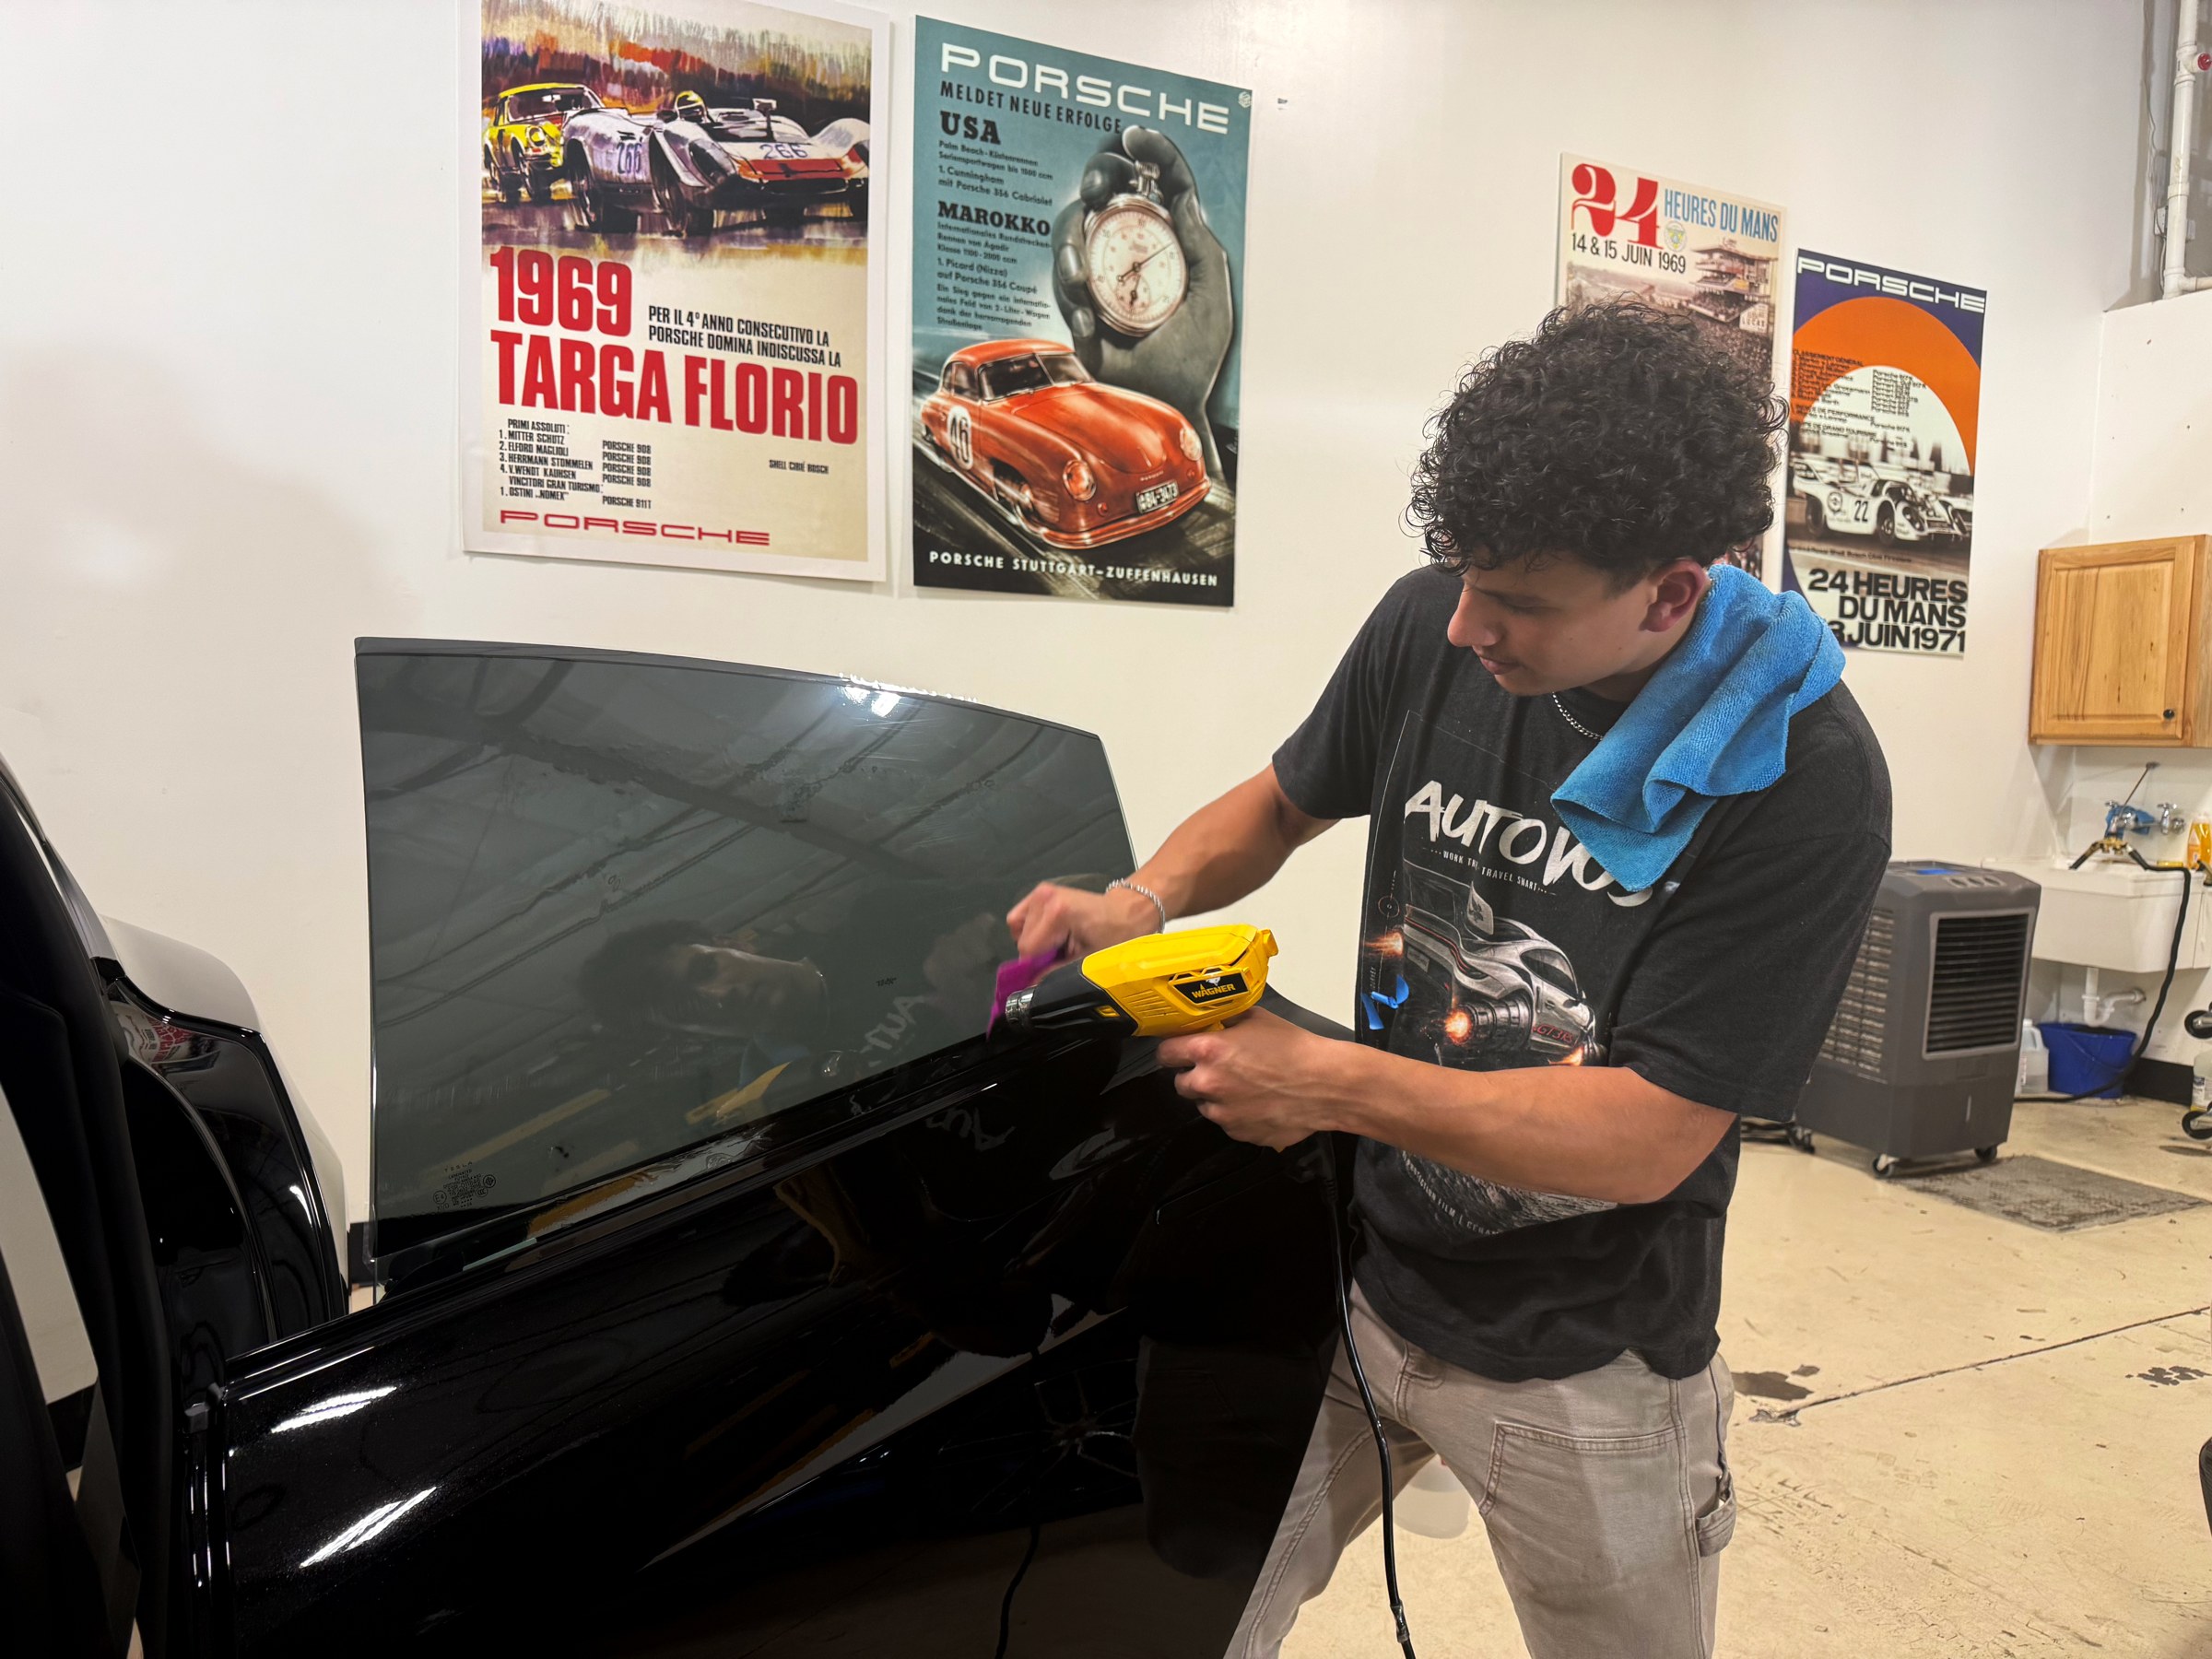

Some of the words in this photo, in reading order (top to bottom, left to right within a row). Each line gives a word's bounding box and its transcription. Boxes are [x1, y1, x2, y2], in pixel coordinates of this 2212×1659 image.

[941, 42, 1229, 135] PORSCHE
[940, 80, 1004, 109] MELDET
[1010, 96, 1051, 120] NEUE
[1056, 106, 1122, 135] ERFOLGE
[940, 111, 1001, 145] USA
[956, 180, 991, 194] Porsche
[937, 200, 1051, 236] MAROKKO
[1571, 162, 1664, 250] 24
[1665, 188, 1716, 229] HEURES
[1720, 202, 1738, 233] DU
[1741, 207, 1779, 243] MANS
[1571, 231, 1586, 253] 14
[1590, 236, 1601, 256] &
[1604, 241, 1618, 259] 15
[1621, 244, 1653, 267] JUIN
[1658, 252, 1687, 274] 1969
[490, 245, 632, 337] 1969
[954, 272, 991, 287] Porsche
[1797, 256, 1986, 313] PORSCHE
[649, 305, 670, 324] PER
[674, 309, 684, 326] IL
[702, 313, 733, 333] ANNO
[737, 319, 813, 345] CONSECUTIVO
[817, 330, 830, 347] LA
[649, 324, 704, 348] PORSCHE
[708, 333, 753, 356] DOMINA
[757, 340, 825, 366] INDISCUSSA
[829, 351, 841, 368] LA
[490, 329, 672, 424] TARGA
[684, 354, 858, 445] FLORIO
[508, 418, 530, 430] PRIMI
[499, 429, 508, 440] 1.
[508, 429, 534, 442] MITTER
[602, 440, 634, 453] PORSCHE
[637, 443, 652, 454] 908
[499, 441, 508, 451] 2.
[508, 441, 534, 453] ELFORD
[535, 444, 569, 457] MAGLIOLI
[602, 452, 634, 464] PORSCHE
[637, 454, 652, 465] 908
[499, 453, 508, 463] 3.
[508, 453, 549, 466] HERRMANN
[551, 457, 594, 470] STOMMELEN
[602, 463, 634, 476] PORSCHE
[637, 465, 652, 477] 908
[500, 464, 508, 474] 4.
[543, 467, 577, 479] KAUHSEN
[602, 474, 634, 486] PORSCHE
[637, 477, 652, 488] 908
[500, 487, 509, 497] 1.
[509, 487, 534, 499] OSTINI
[602, 495, 634, 508] PORSCHE
[509, 476, 545, 488] VINCITORI
[547, 479, 567, 490] GRAN
[500, 510, 770, 547] PORSCHE
[1854, 500, 1869, 523] 22
[929, 550, 1005, 570] PORSCHE
[1013, 558, 1218, 587] STUTTGART-ZUFFENHAUSEN
[1808, 568, 1849, 594] 24
[1853, 571, 1968, 604] HEURES
[1839, 595, 1878, 621] DU
[1884, 599, 1967, 629] MANS
[1848, 622, 1911, 649] JUIN
[1912, 627, 1967, 653] 1971
[1443, 850, 1464, 865] WORK
[1481, 866, 1513, 882] TRAVEL
[1516, 876, 1538, 891] SMART
[1192, 983, 1236, 998] WAGNER
[1437, 1198, 1456, 1217] FILM
